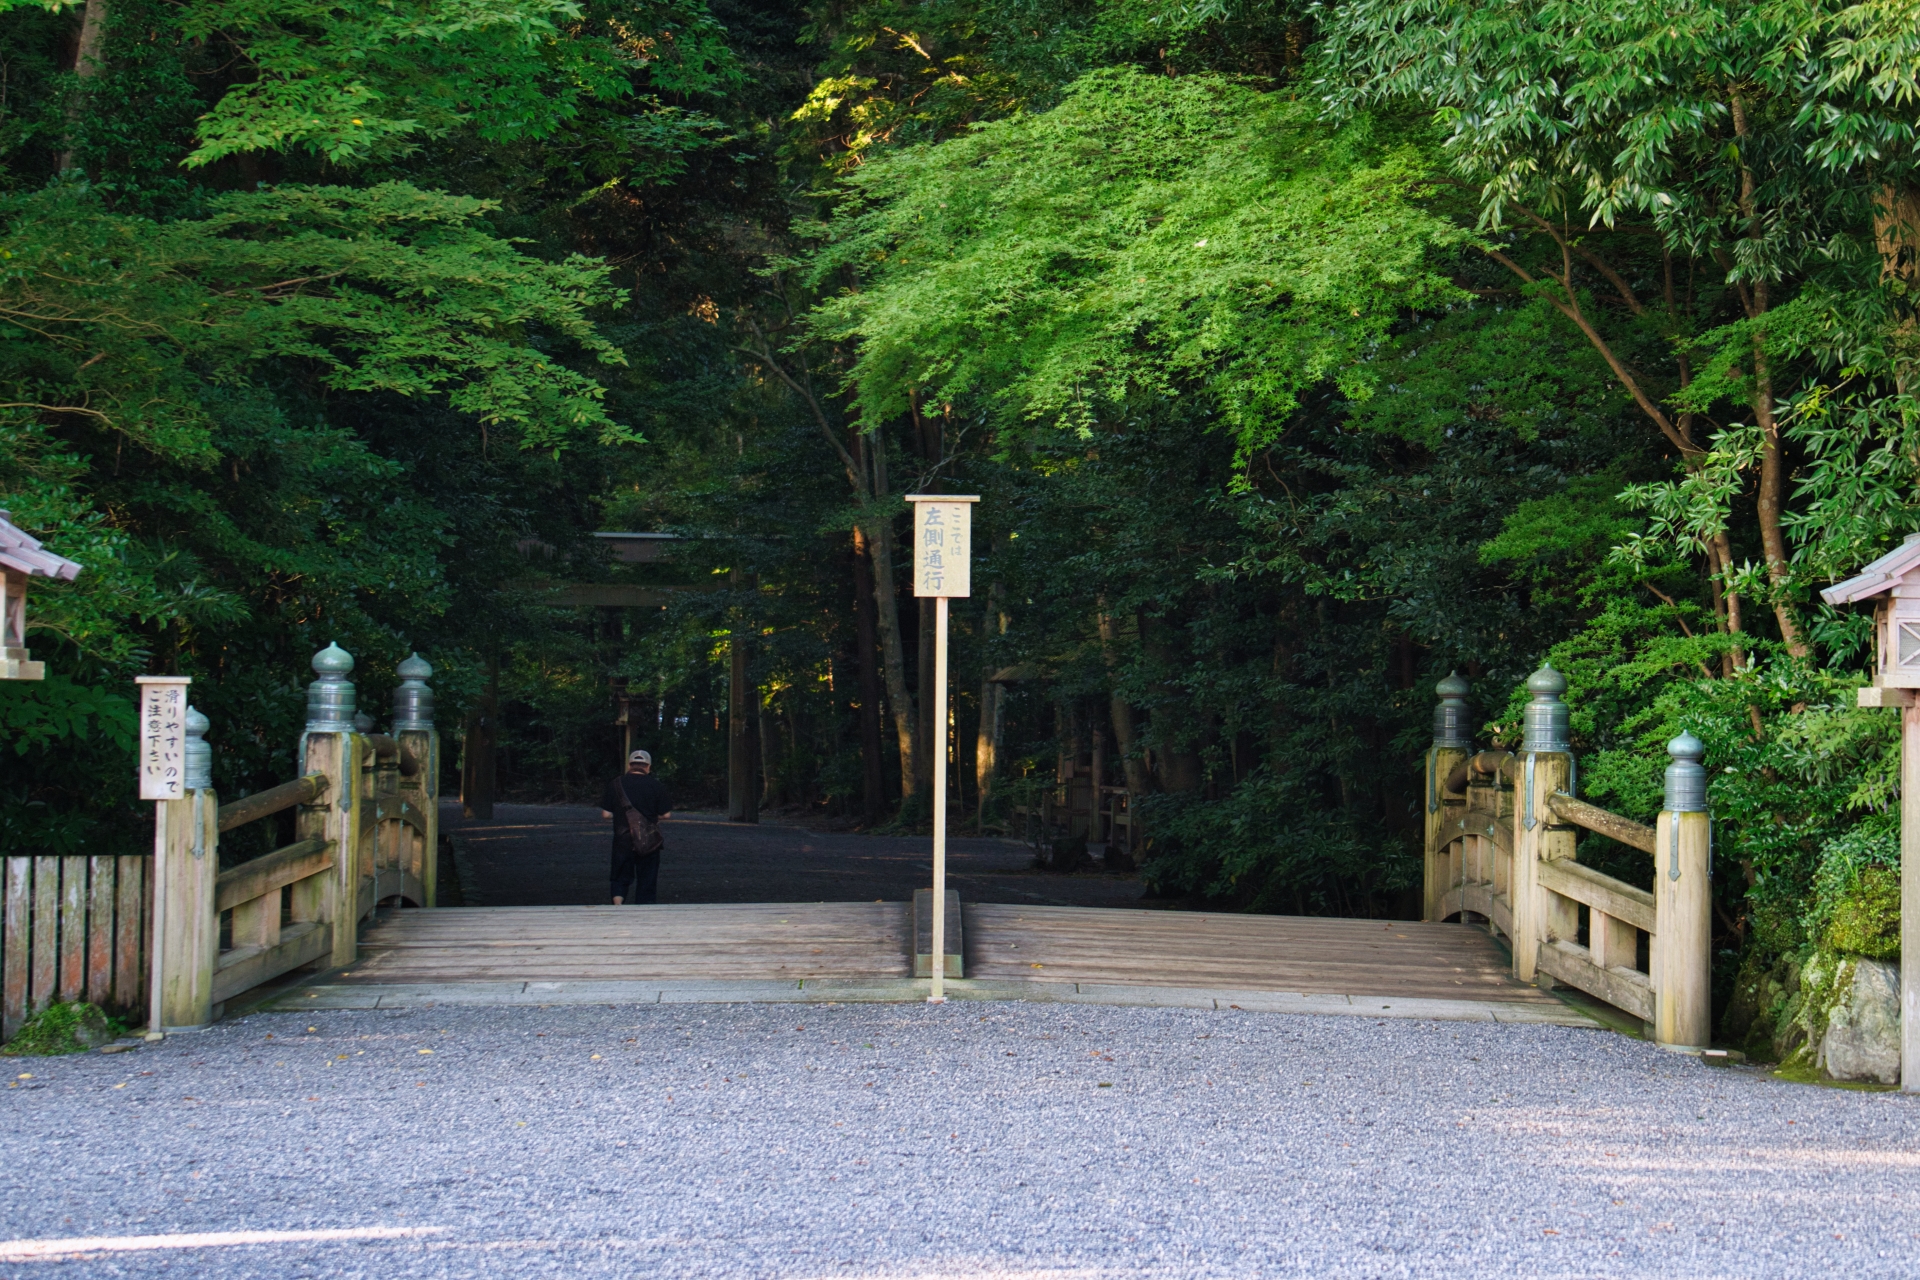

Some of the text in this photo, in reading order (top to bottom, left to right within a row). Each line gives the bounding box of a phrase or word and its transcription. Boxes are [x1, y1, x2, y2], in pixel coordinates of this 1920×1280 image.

[923, 506, 945, 591] 左側通行
[950, 507, 963, 556] ここでは
[147, 690, 162, 775] ご注意下さい
[165, 689, 180, 793] 滑りやすいので
